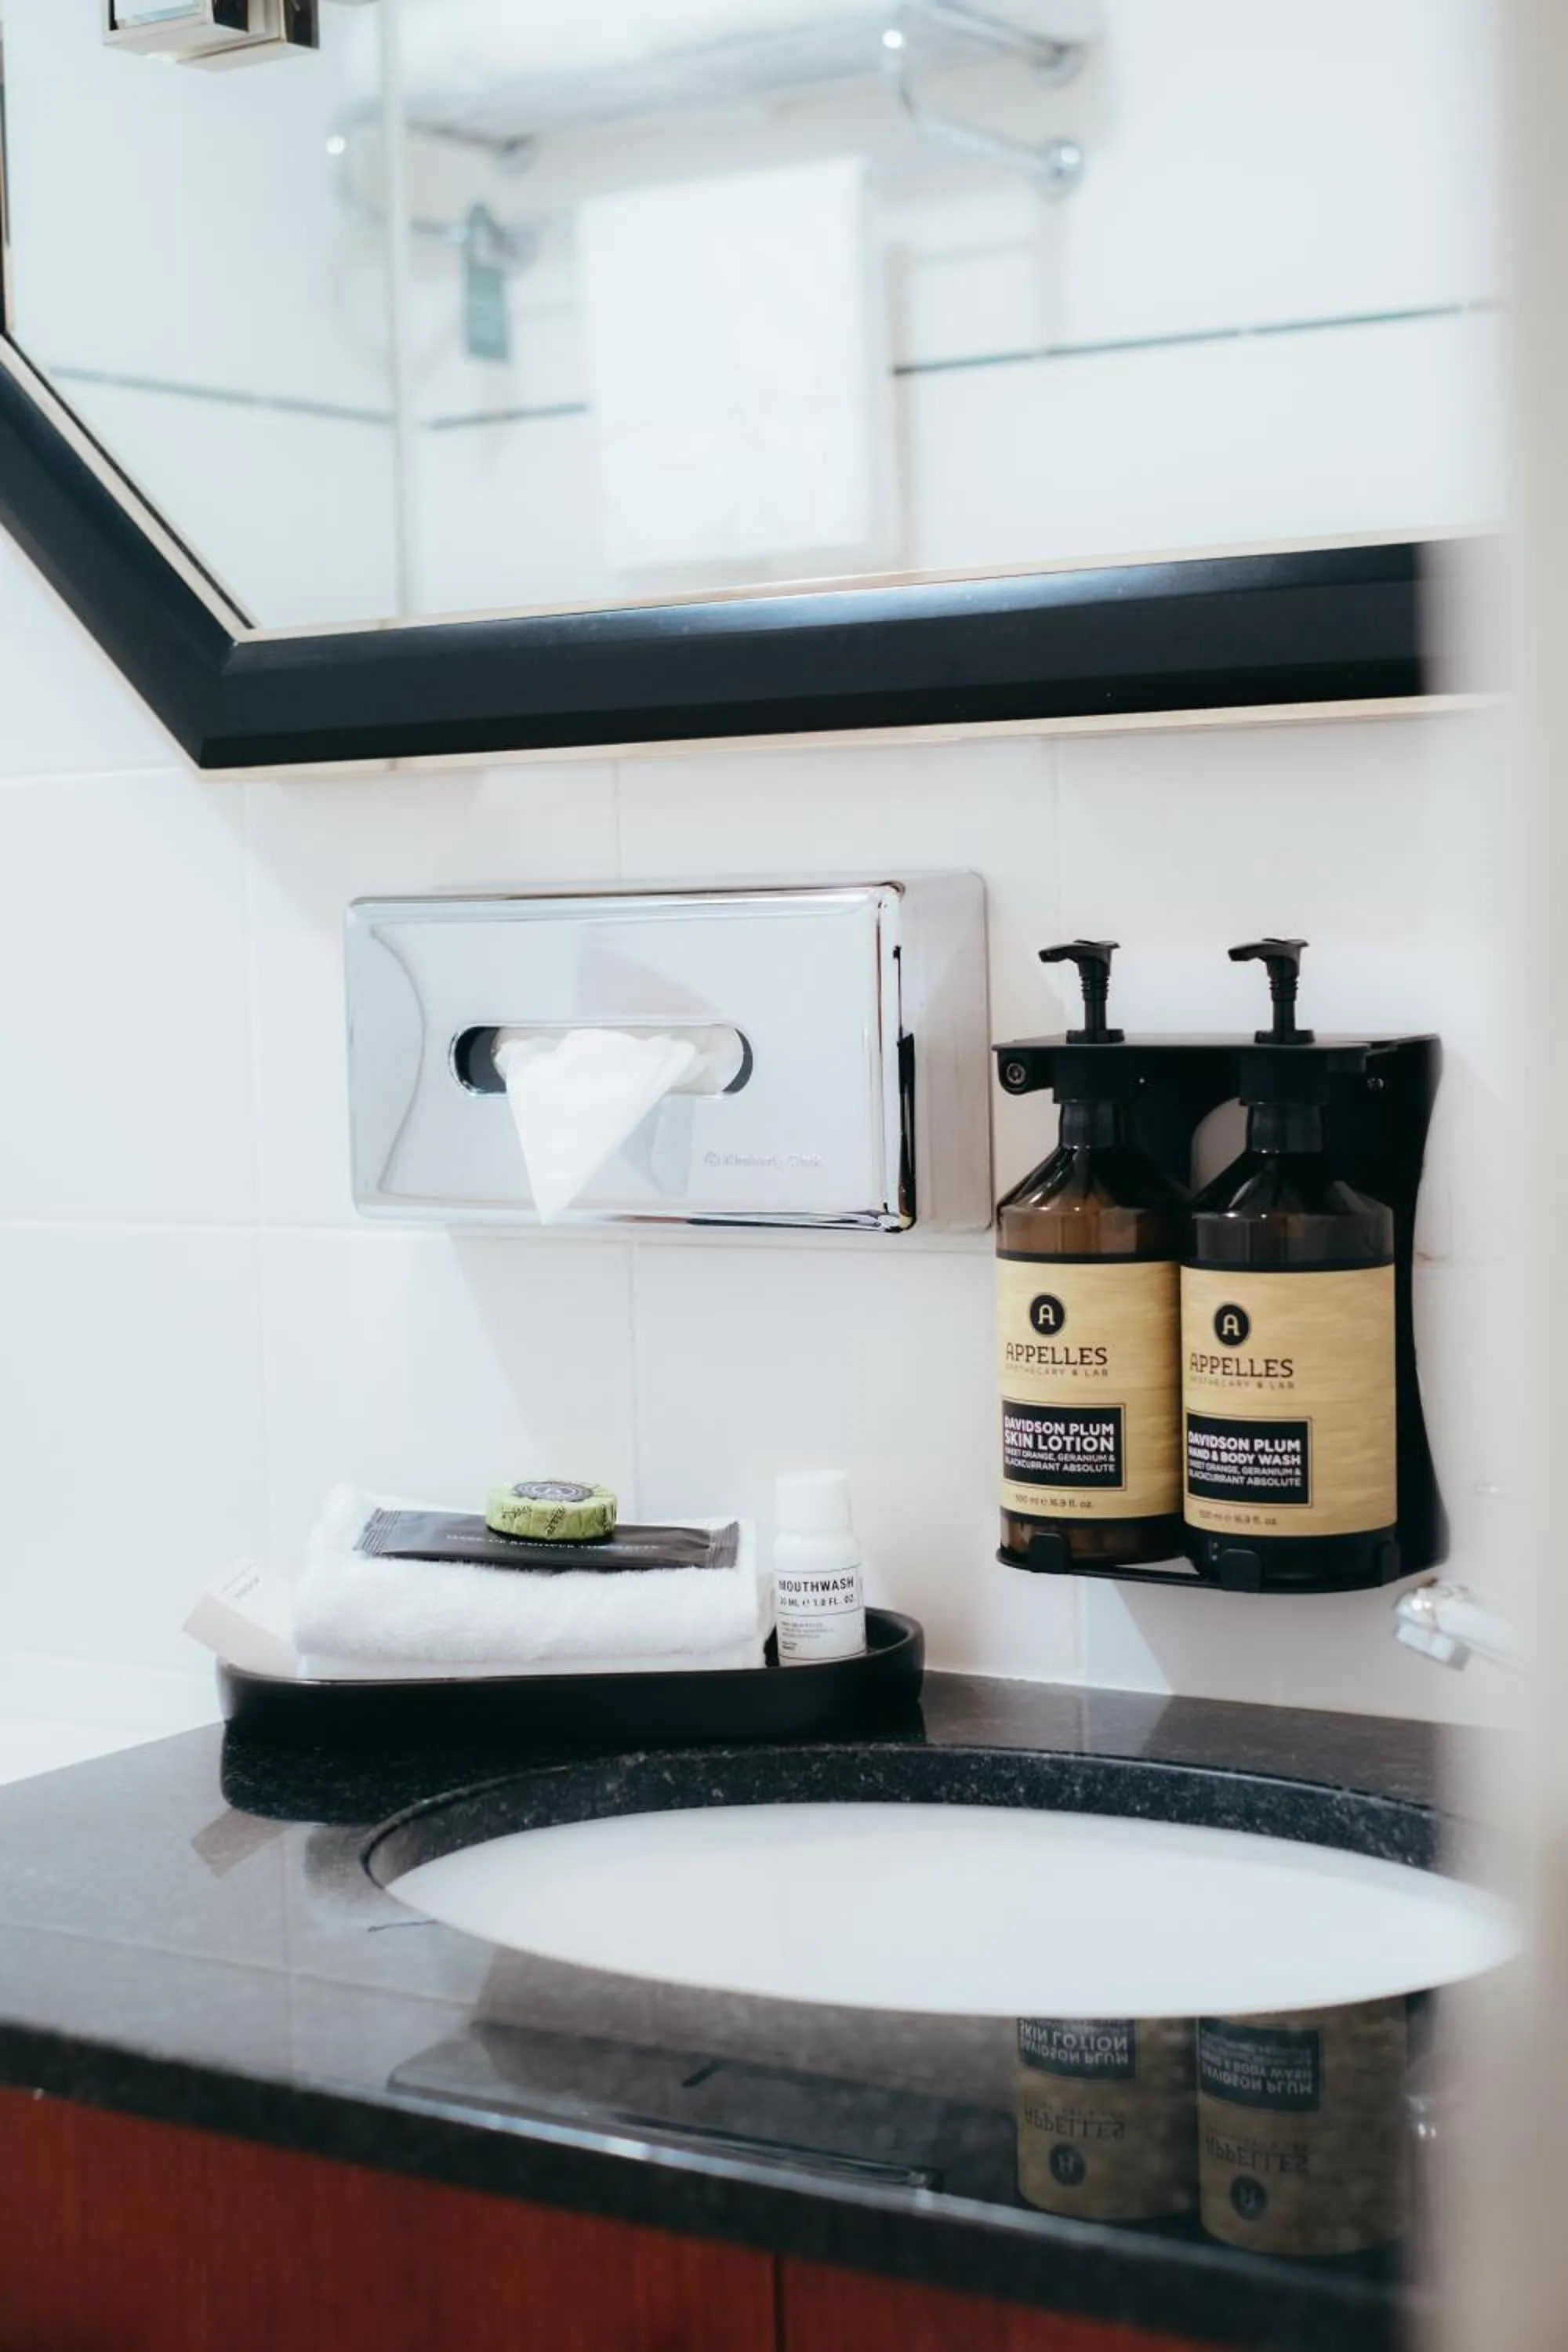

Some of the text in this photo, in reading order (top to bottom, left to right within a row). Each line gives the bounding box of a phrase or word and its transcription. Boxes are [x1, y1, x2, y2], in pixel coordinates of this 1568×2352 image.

[1006, 1342, 1108, 1365] APPELLES
[1190, 1352, 1294, 1377] APPELLES
[1004, 1415, 1115, 1436] DAVIDSON PLUM
[1004, 1429, 1115, 1453] SKIN LOTION
[1188, 1430, 1301, 1453] DAVIDSON PLUM
[1058, 1453, 1108, 1463] GERANIUM
[1220, 1451, 1254, 1465] BODY
[1257, 1454, 1301, 1465] WASH
[1062, 1463, 1116, 1473] ABSOLUTE
[1241, 1466, 1293, 1476] GERANIUM
[1246, 1476, 1301, 1486] ABSOLUTE
[779, 1576, 854, 1592] MOUTHWASH
